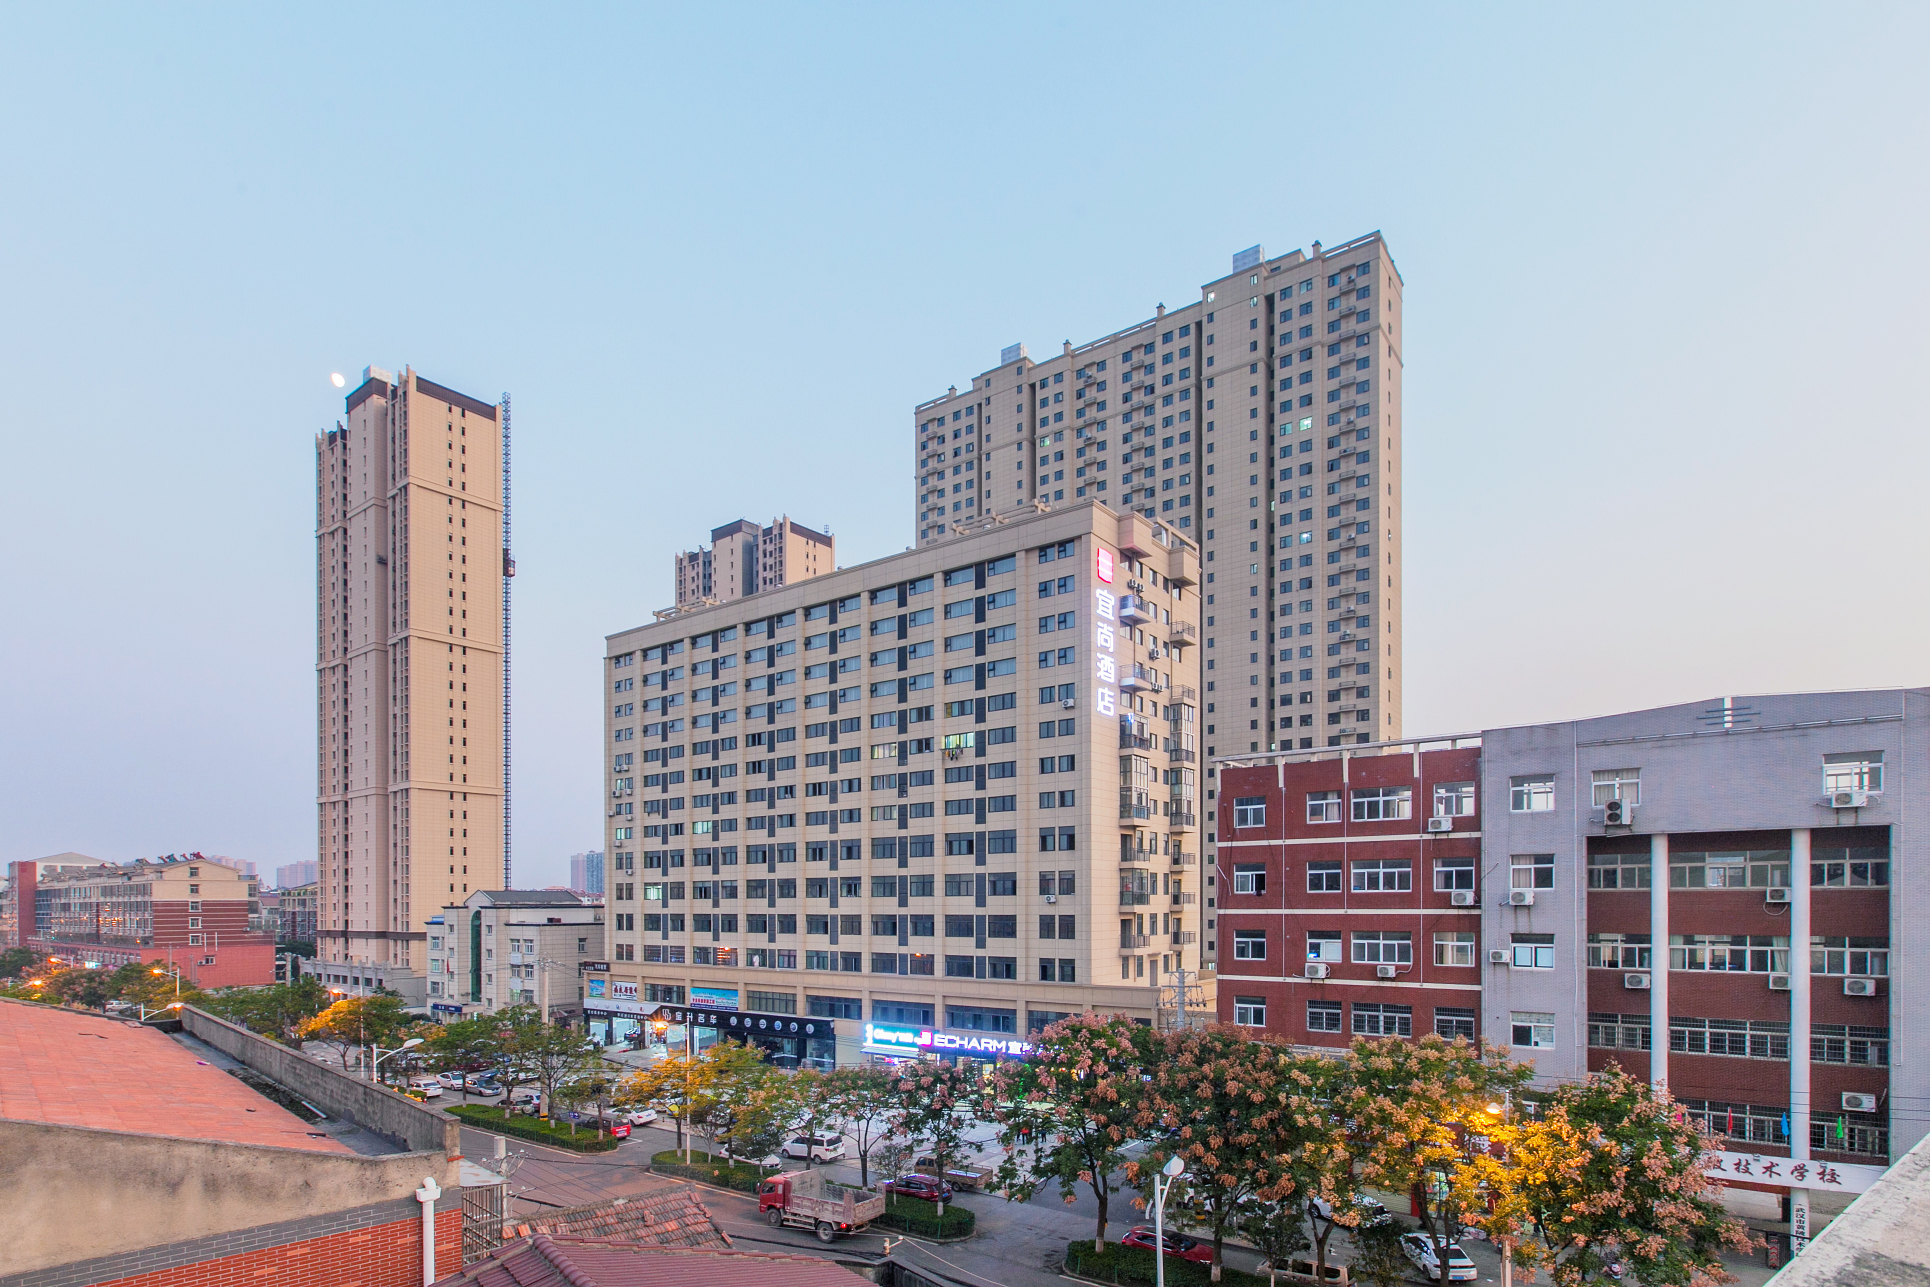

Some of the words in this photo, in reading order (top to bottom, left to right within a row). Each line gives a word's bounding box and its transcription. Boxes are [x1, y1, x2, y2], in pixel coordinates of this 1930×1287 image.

[1095, 588, 1115, 717] 宜尚酒店
[933, 1033, 1007, 1053] ECHARM
[1795, 1207, 1806, 1257] 武汉市黄陂技术学
